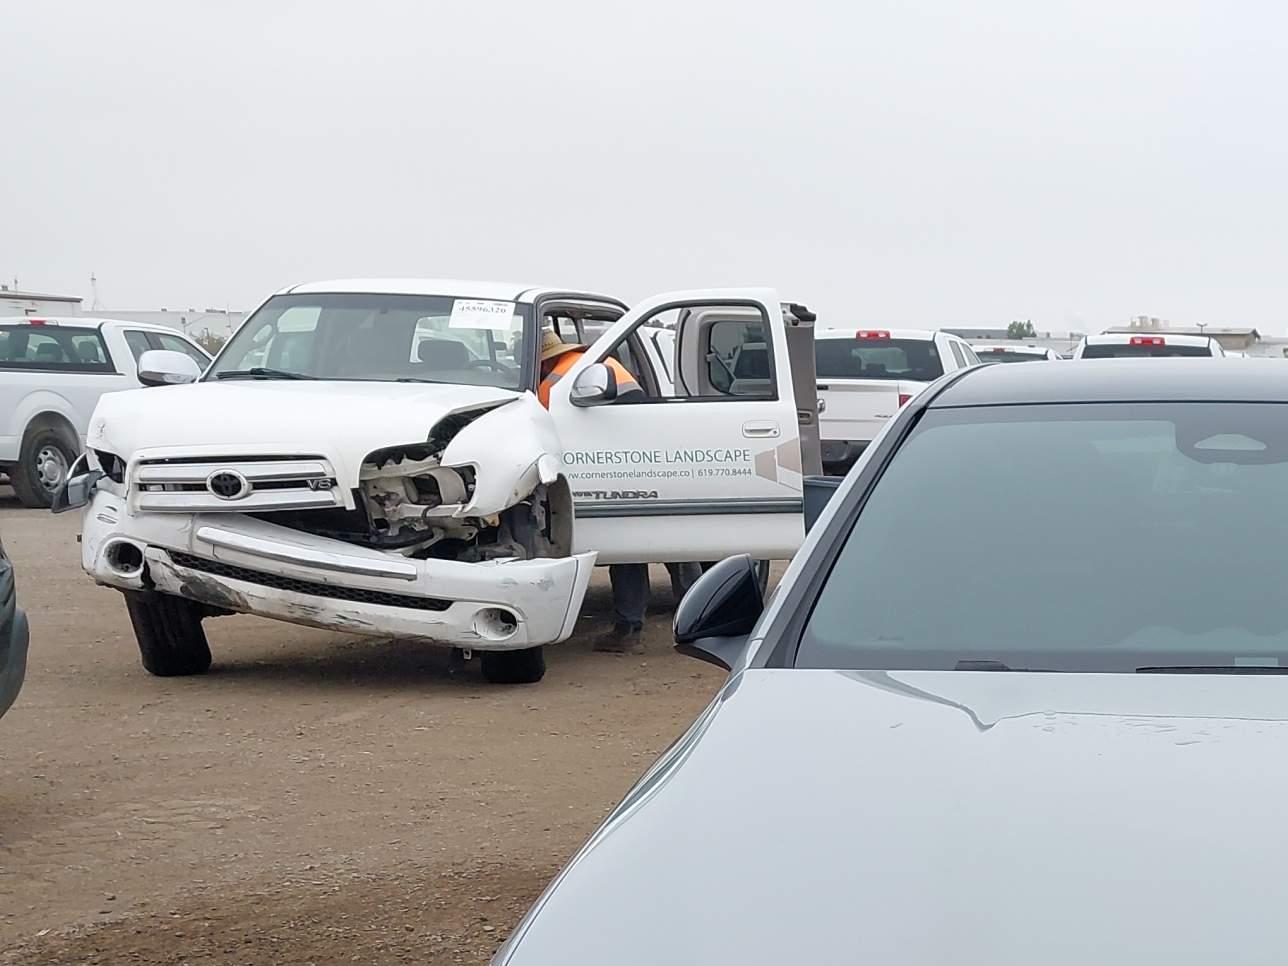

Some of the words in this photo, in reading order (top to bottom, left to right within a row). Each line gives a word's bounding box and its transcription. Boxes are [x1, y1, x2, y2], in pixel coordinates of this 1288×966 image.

[561, 450, 661, 465] ORNERSTONE
[665, 449, 751, 463] LANDSCAPE
[593, 490, 659, 500] TUNDRA
